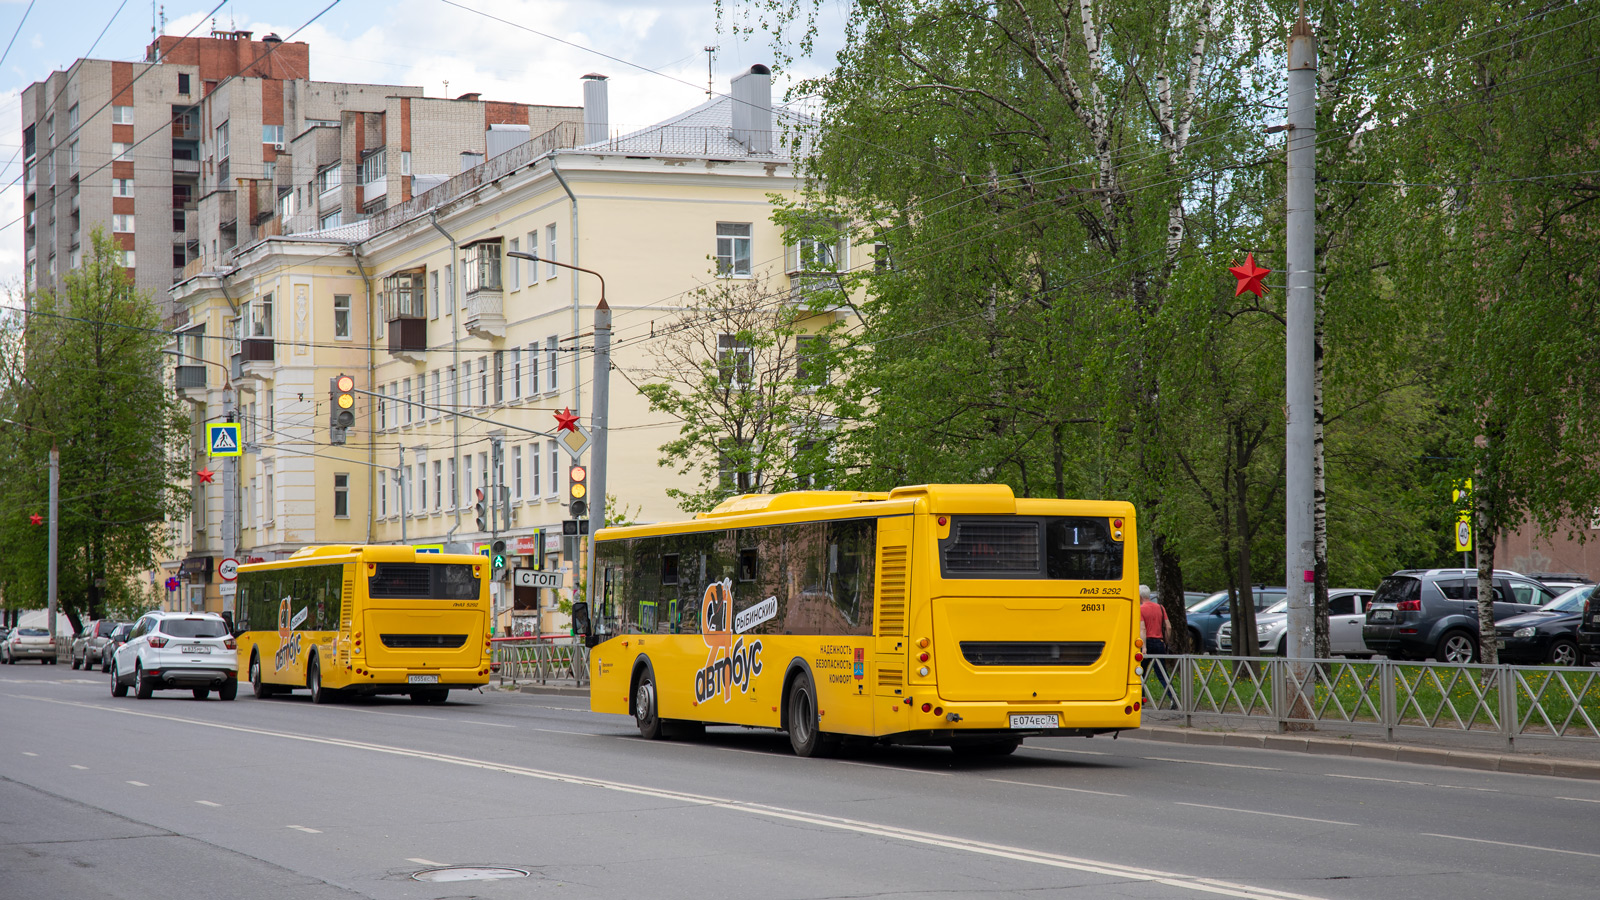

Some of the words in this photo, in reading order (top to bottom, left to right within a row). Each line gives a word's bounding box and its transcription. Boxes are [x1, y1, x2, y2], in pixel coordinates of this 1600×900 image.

[1073, 527, 1079, 545] 1
[522, 573, 557, 586] СТОП
[1101, 587, 1122, 595] 5292
[736, 598, 777, 630] РЫБИНСКИЙ
[820, 645, 852, 655] НАДЕЖНОСТЬ
[816, 659, 852, 669] БЕЗОПАСНОСТЬ
[829, 674, 852, 684] КОМФОРТ
